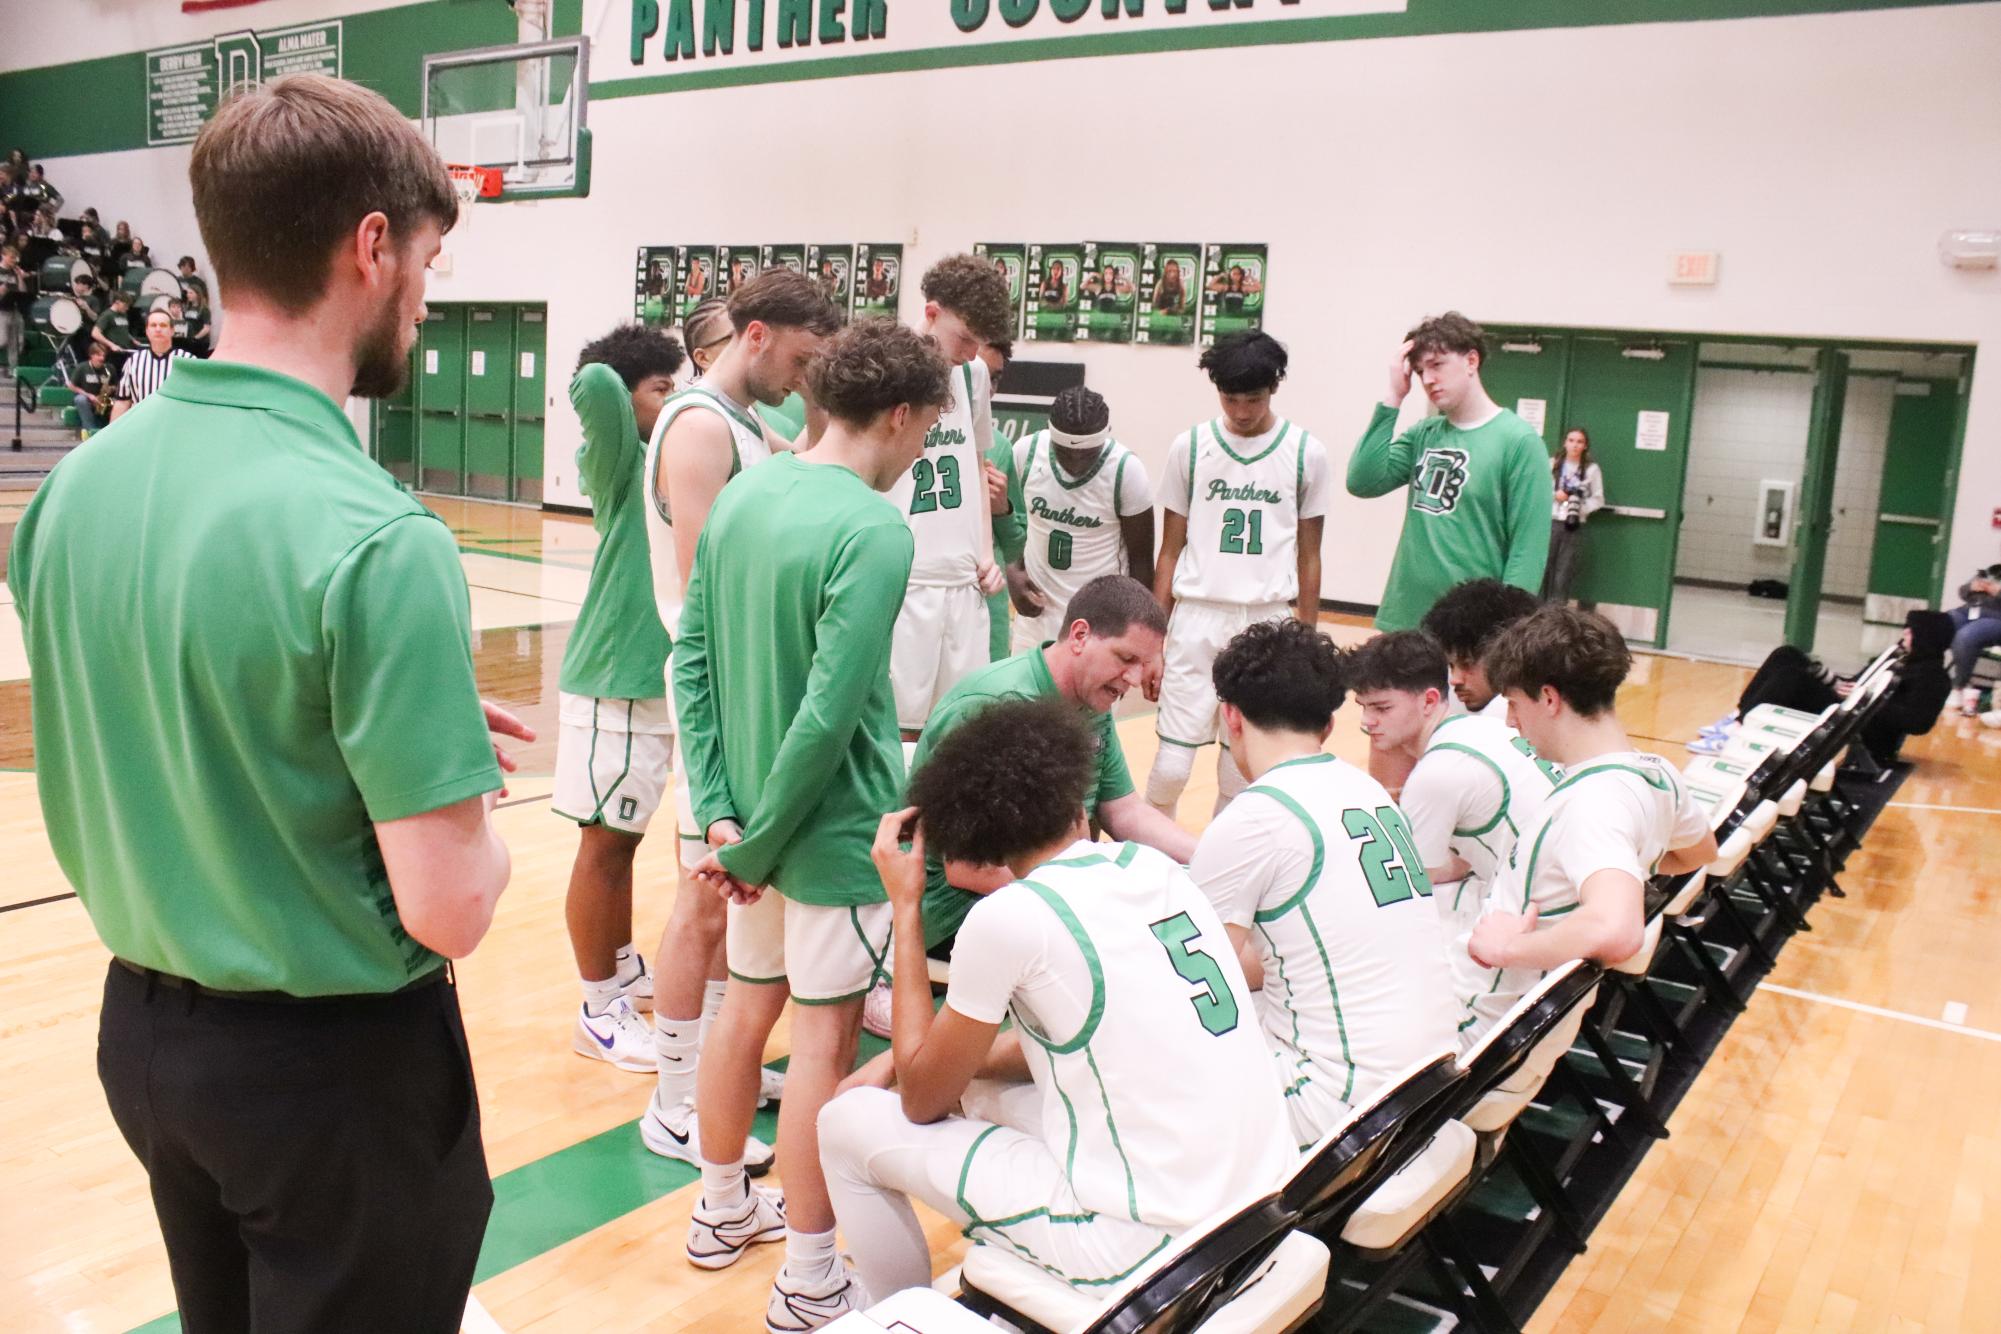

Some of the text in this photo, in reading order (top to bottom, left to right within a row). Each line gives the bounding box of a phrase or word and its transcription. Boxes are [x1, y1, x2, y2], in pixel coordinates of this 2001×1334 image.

[1024, 245, 1042, 340] PANTHER
[1136, 244, 1156, 343] PANTHER
[909, 454, 963, 515] 23
[1030, 496, 1104, 528] Panthers
[1205, 478, 1282, 504] Panthers
[1048, 529, 1073, 571] 0
[1219, 508, 1262, 555] 21
[1341, 806, 1433, 908] 20
[1148, 910, 1239, 1037] 5
